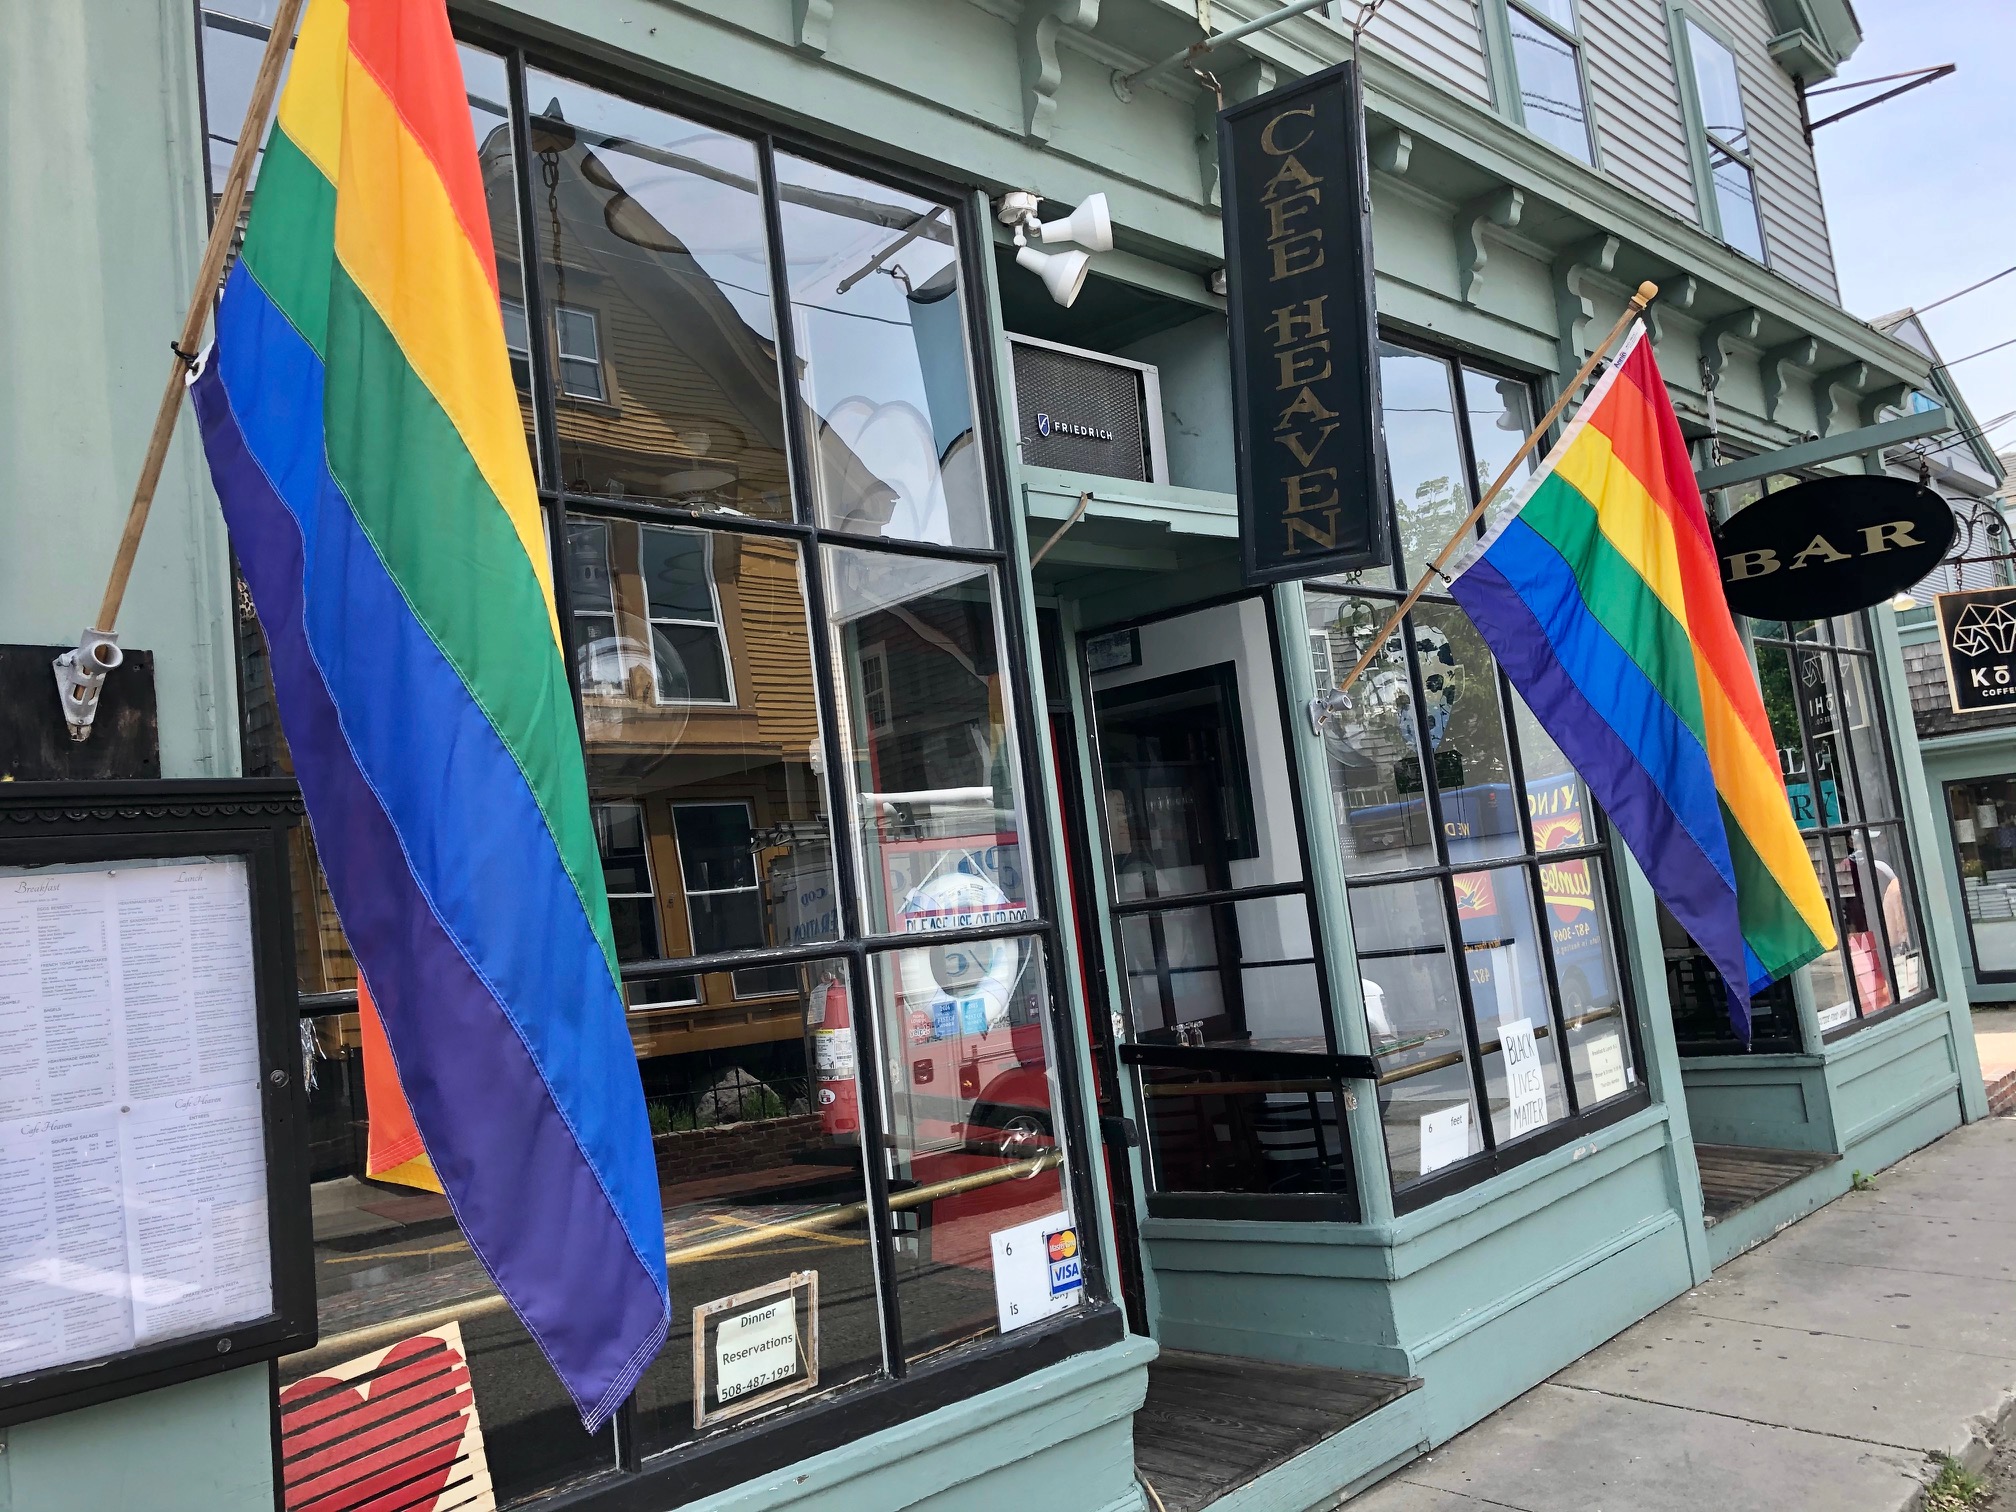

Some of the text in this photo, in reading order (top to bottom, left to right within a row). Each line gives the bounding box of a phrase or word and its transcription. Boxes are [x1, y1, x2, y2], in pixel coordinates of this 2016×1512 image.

[1261, 104, 1341, 557] CAFE HEAVEN
[1054, 421, 1113, 441] FRIEDRICH
[1722, 520, 1926, 582] BAR
[174, 868, 207, 883] Lunch
[14, 877, 61, 896] Breakfast
[1505, 1033, 1536, 1066] BLACK
[1512, 1068, 1541, 1099] LIVES
[175, 1094, 222, 1111] Cafe Heaven
[1513, 1097, 1545, 1130] MATTER
[21, 1119, 73, 1137] Cafe Heaven
[1428, 1115, 1463, 1133] 6 feet
[51, 1137, 68, 1145] SOUPS
[79, 1133, 99, 1141] SALADS
[1006, 1242, 1013, 1256] 6
[1049, 1240, 1077, 1254] MasterCard
[1054, 1262, 1079, 1282] VISA
[740, 1307, 777, 1328] Dinner
[1009, 1302, 1019, 1316] is
[722, 1333, 794, 1366] Reservations
[721, 1362, 796, 1401] 508-487-1991
